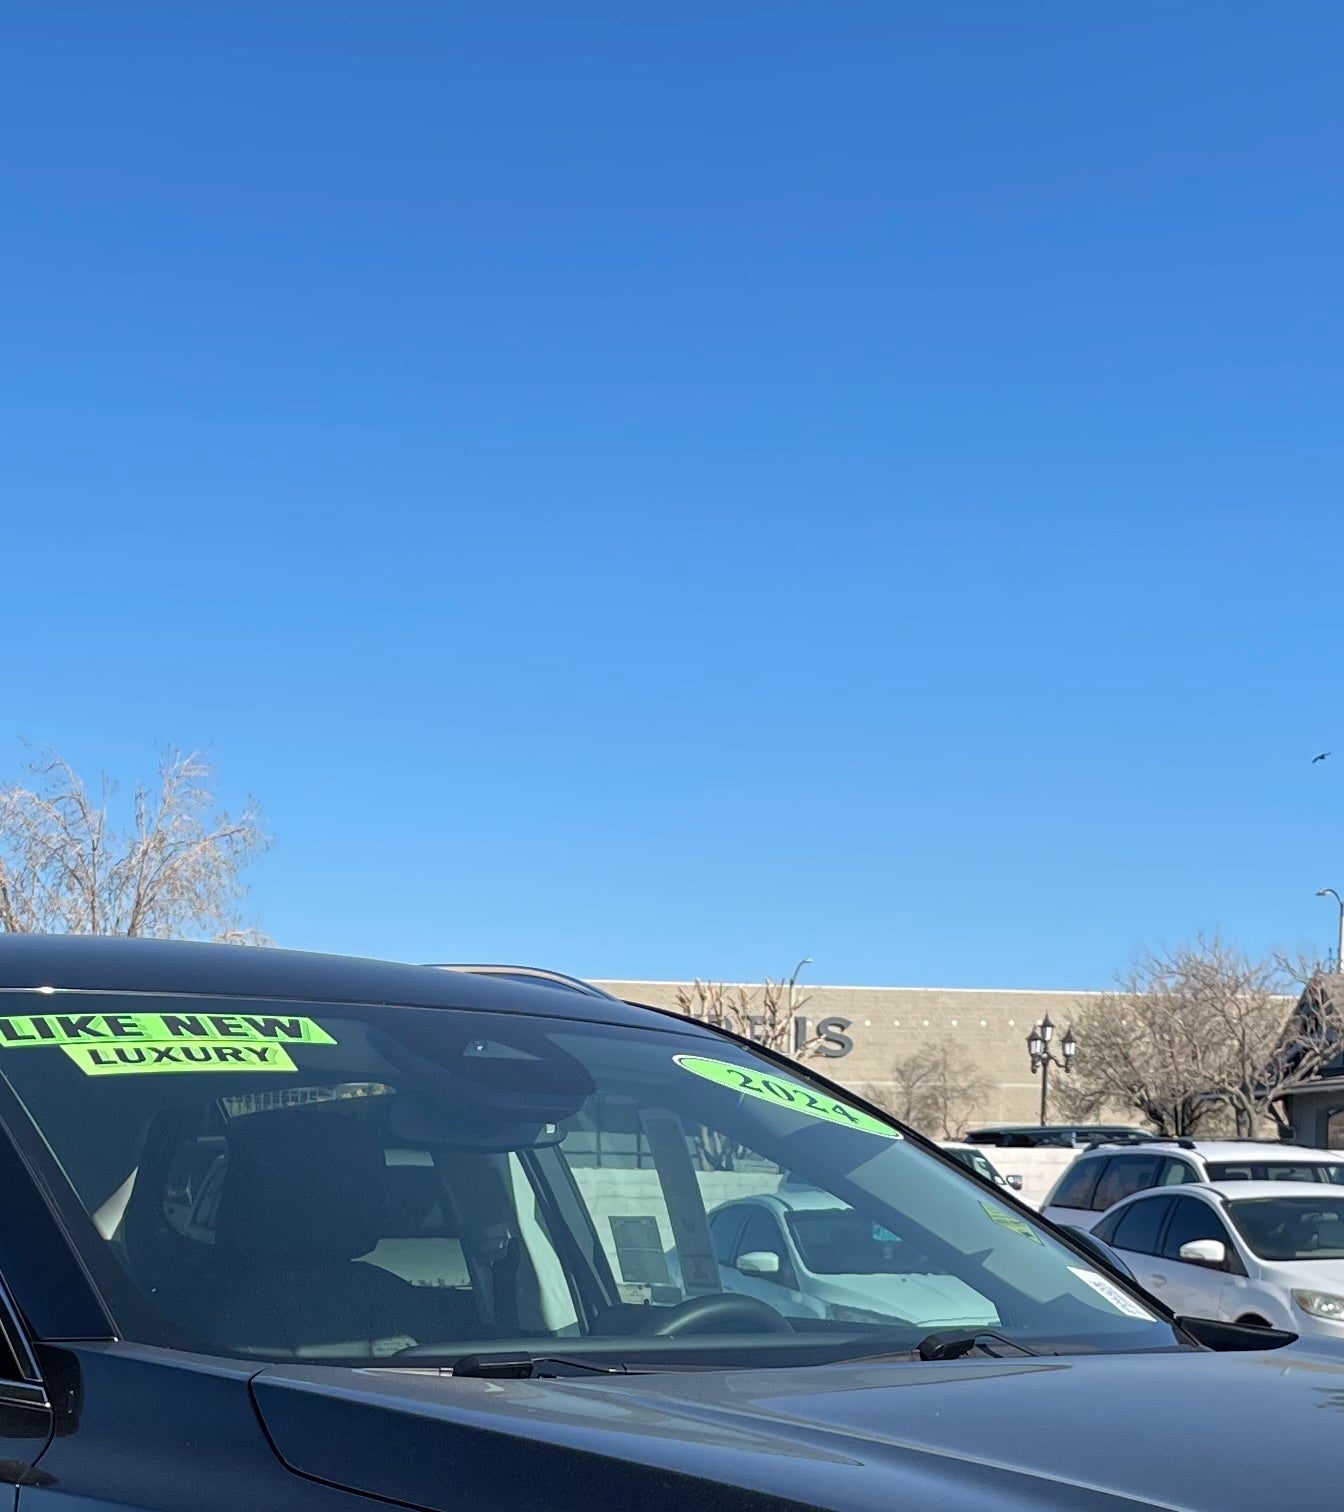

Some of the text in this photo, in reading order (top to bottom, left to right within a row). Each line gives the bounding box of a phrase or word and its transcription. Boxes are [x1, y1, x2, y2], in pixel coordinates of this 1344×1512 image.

[160, 1015, 307, 1040] NEW
[88, 1045, 273, 1065] LUXURY
[726, 1069, 860, 1123] 2024
